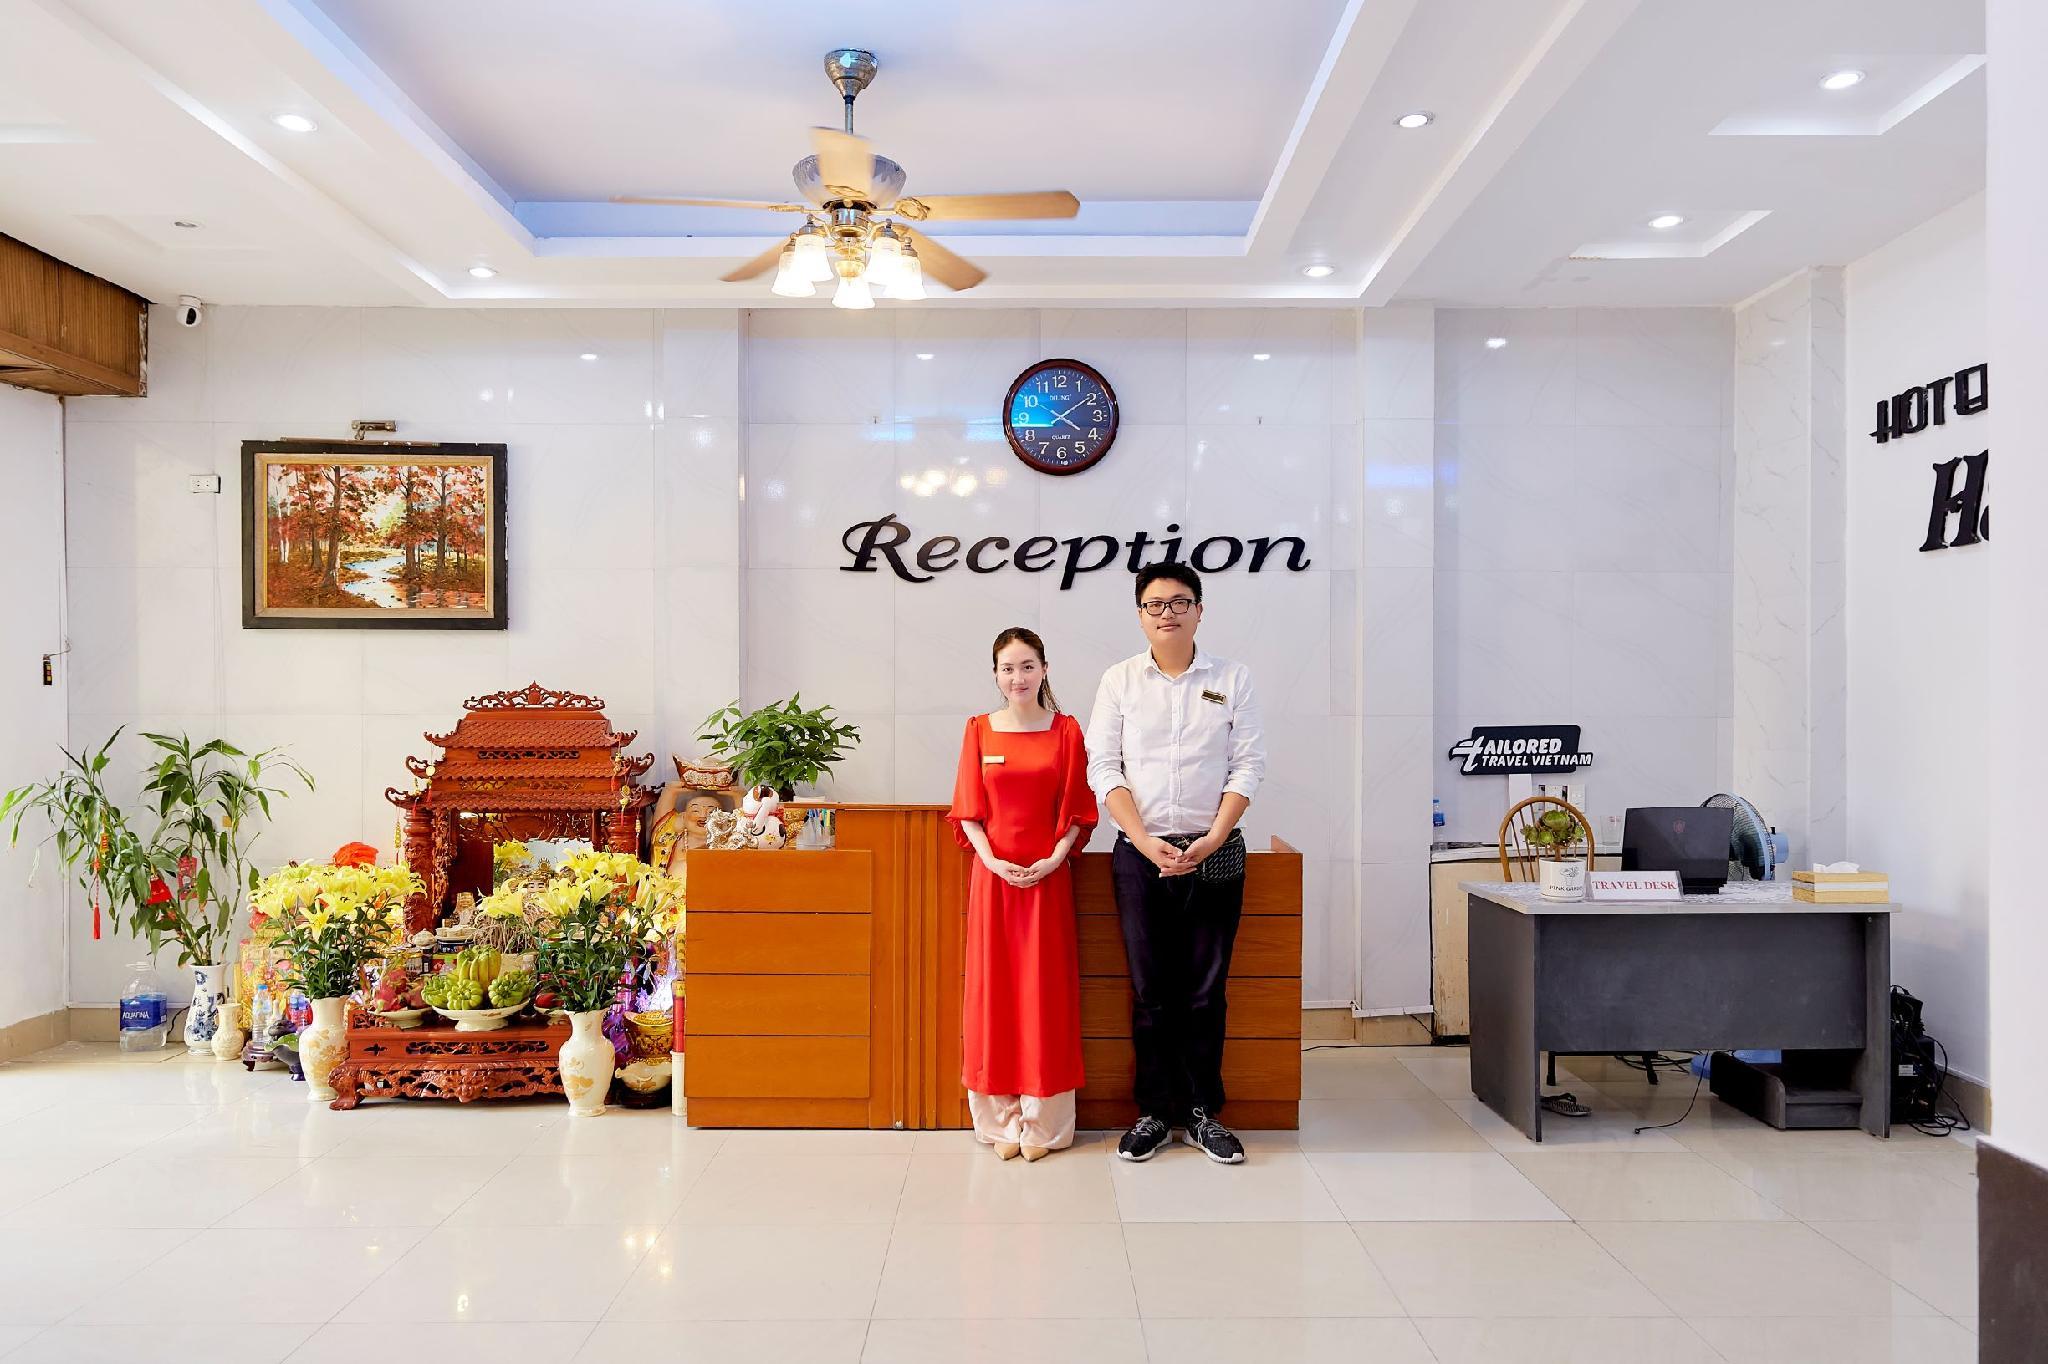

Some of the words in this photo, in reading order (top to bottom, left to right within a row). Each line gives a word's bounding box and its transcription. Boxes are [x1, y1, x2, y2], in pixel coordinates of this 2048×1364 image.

[1036, 381, 1049, 393] 11
[1052, 375, 1067, 388] 12
[1075, 380, 1081, 392] 1
[1023, 395, 1038, 408] 10
[1086, 392, 1097, 406] 2
[1018, 412, 1029, 425] 9
[1092, 409, 1103, 422] 3
[1025, 429, 1035, 441] 8
[1087, 427, 1098, 440] 4
[1038, 441, 1050, 454] 7
[1056, 446, 1067, 459] 6
[1074, 441, 1086, 454] 5
[1919, 448, 1989, 552] H
[840, 513, 1311, 590] Reception
[1481, 754, 1529, 767] TRAVEL
[1532, 753, 1592, 766] VIETNAM
[1592, 880, 1642, 890] TRAVEL
[1645, 880, 1677, 890] DESK
[122, 1010, 150, 1020] AQUAFINA
